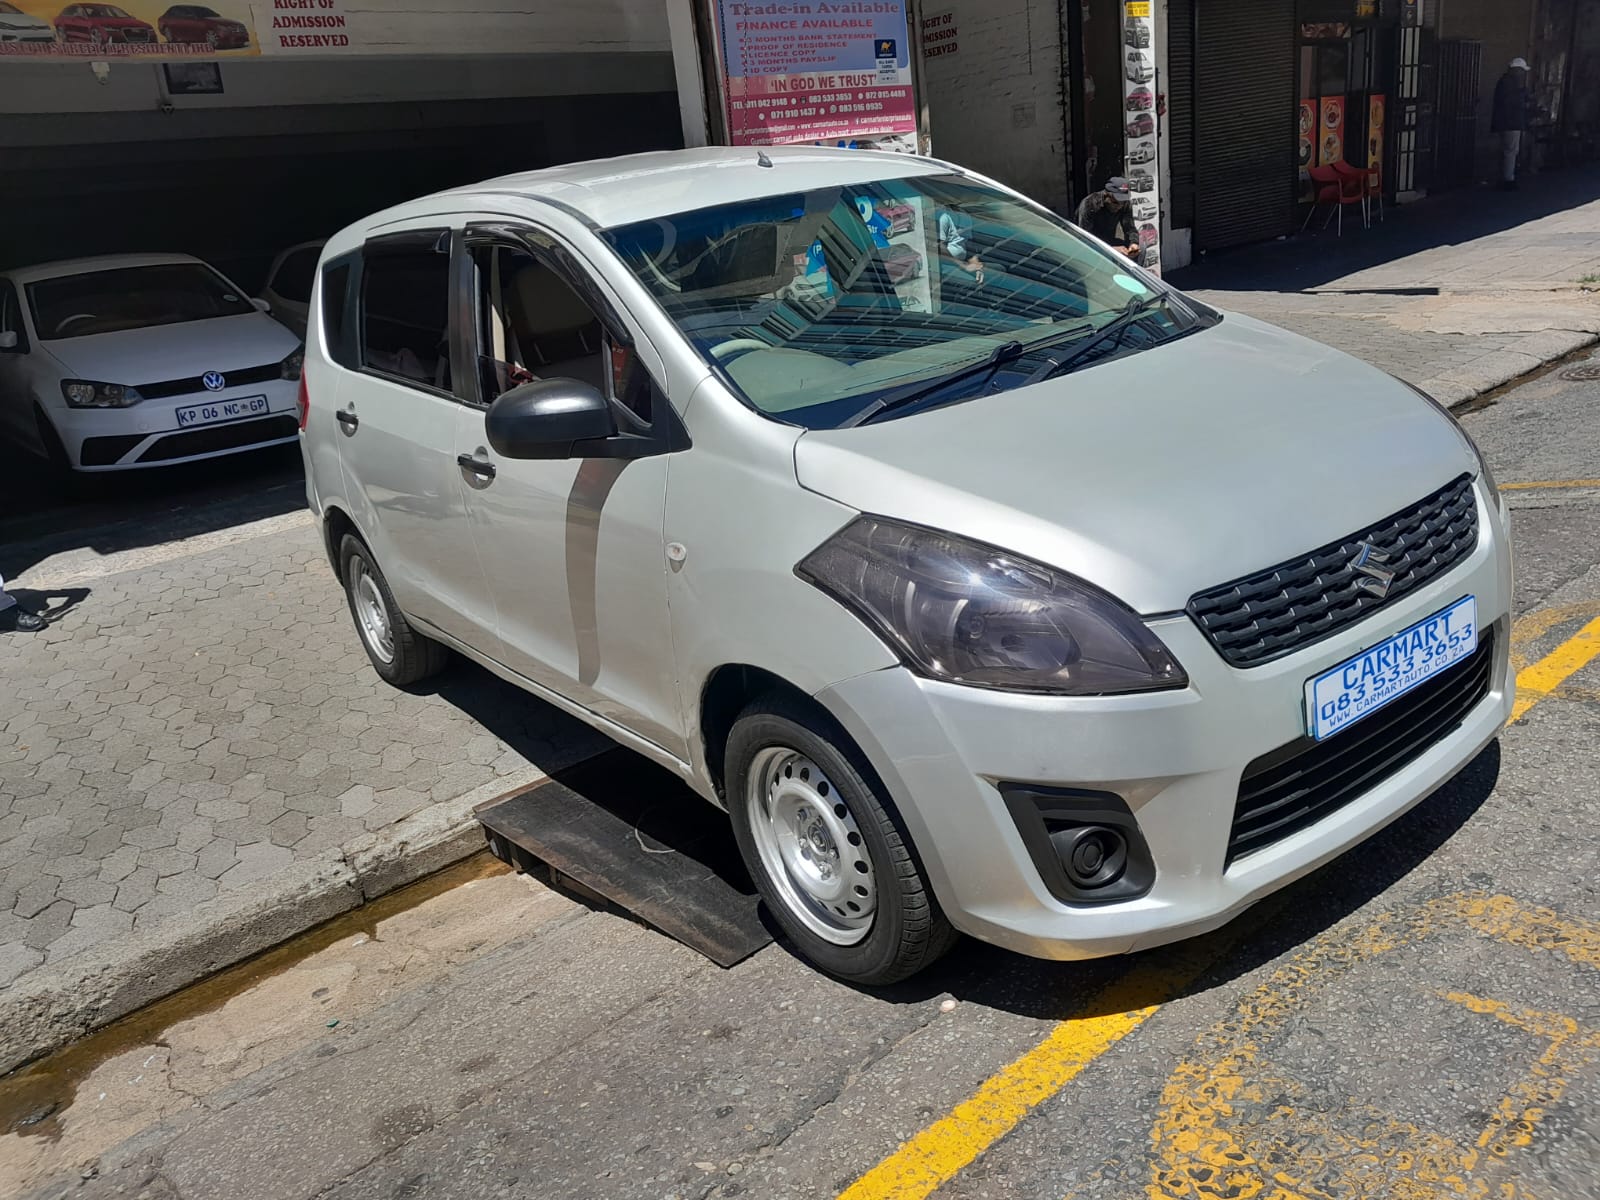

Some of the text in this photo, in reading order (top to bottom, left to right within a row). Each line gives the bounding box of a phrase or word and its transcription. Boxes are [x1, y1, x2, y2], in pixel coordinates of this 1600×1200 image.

[274, 0, 334, 9] RIGHT OF
[729, 1, 899, 16] Trade-in Available
[272, 16, 345, 28] ADMISSION
[736, 19, 873, 31] FINANCE AVAILABLE
[923, 13, 953, 29] IGHT OF
[279, 35, 349, 47] RESERVED
[755, 35, 796, 43] MONTHS
[748, 49, 816, 59] LICENCE COPY
[924, 42, 958, 58] ESERVED
[758, 58, 799, 66] MONTHS
[791, 78, 815, 90] GOD
[818, 77, 836, 88] WE
[179, 399, 265, 424] KP 06 NC GP
[1342, 611, 1454, 691] CARMART
[1321, 623, 1473, 721] 083 533 3653
